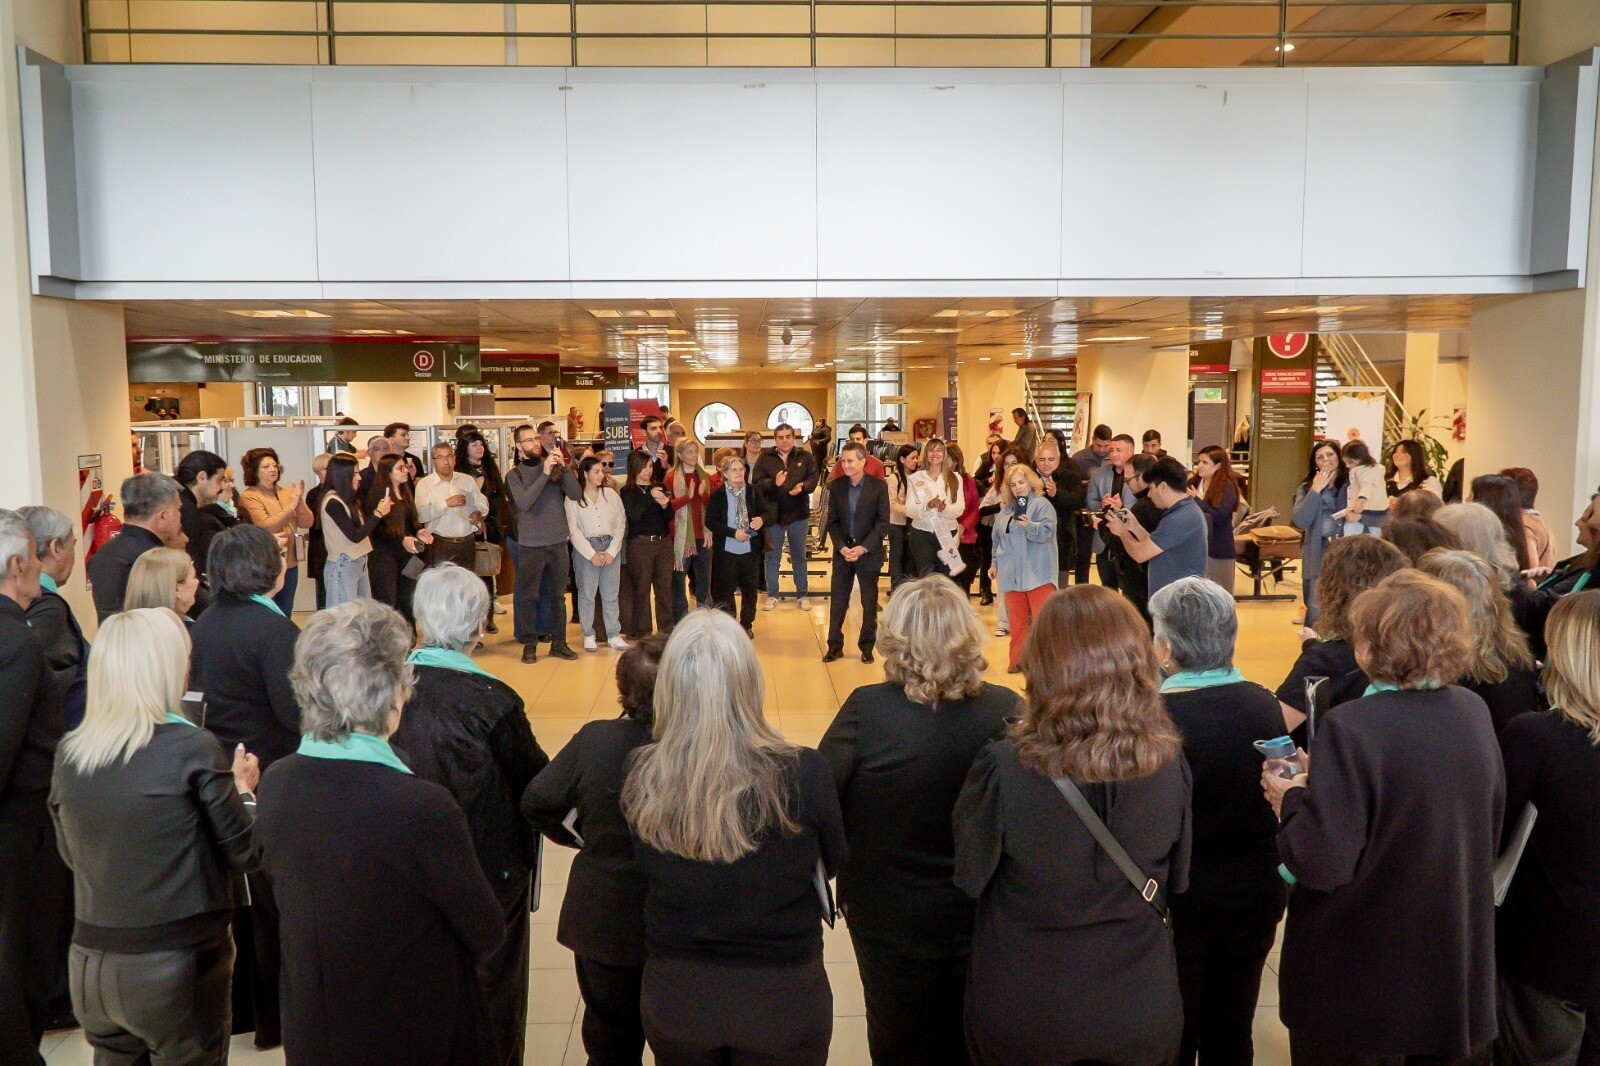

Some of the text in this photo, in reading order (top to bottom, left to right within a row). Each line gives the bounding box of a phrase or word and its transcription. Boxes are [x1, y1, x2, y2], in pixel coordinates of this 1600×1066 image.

[204, 354, 322, 364] MINISTERIO DE EDUCACION
[419, 354, 429, 366] D
[605, 425, 629, 439] SUBE
